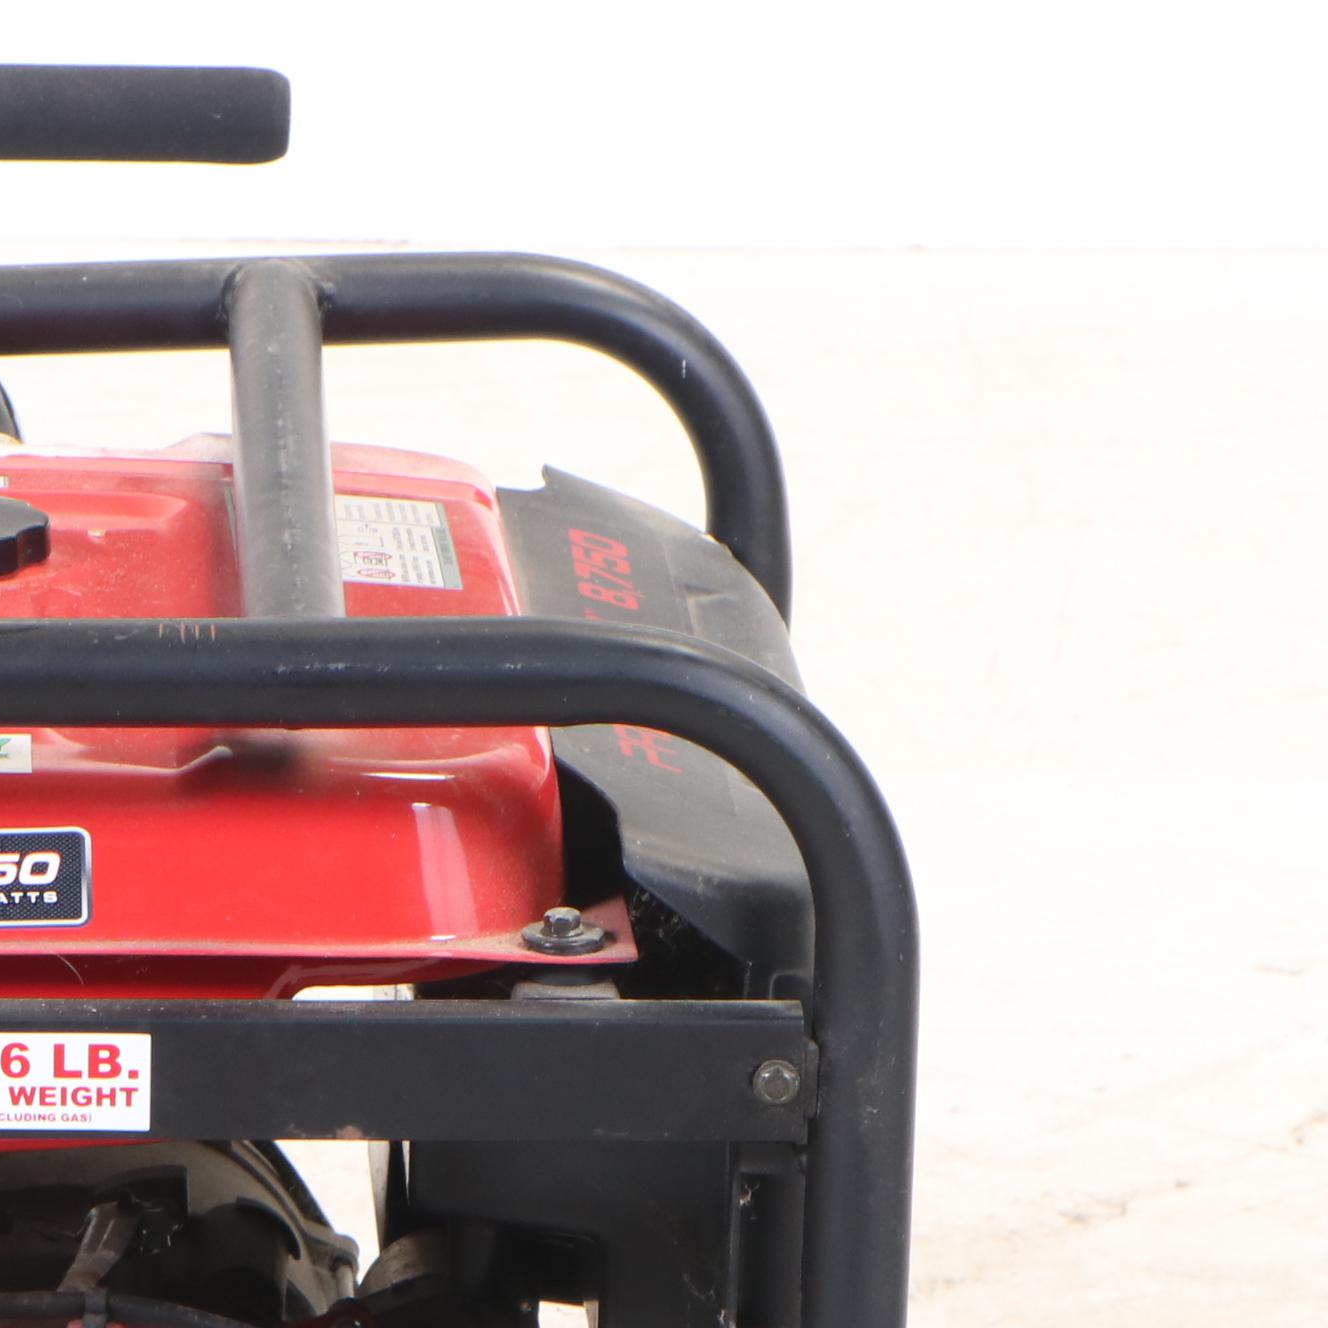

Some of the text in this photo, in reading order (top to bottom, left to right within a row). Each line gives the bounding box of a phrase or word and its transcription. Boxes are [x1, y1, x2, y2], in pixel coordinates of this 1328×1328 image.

[568, 529, 639, 611] 8750
[52, 1043, 140, 1080] LB.
[8, 1086, 139, 1107] WEIGHT
[60, 1112, 93, 1123] GAS)
